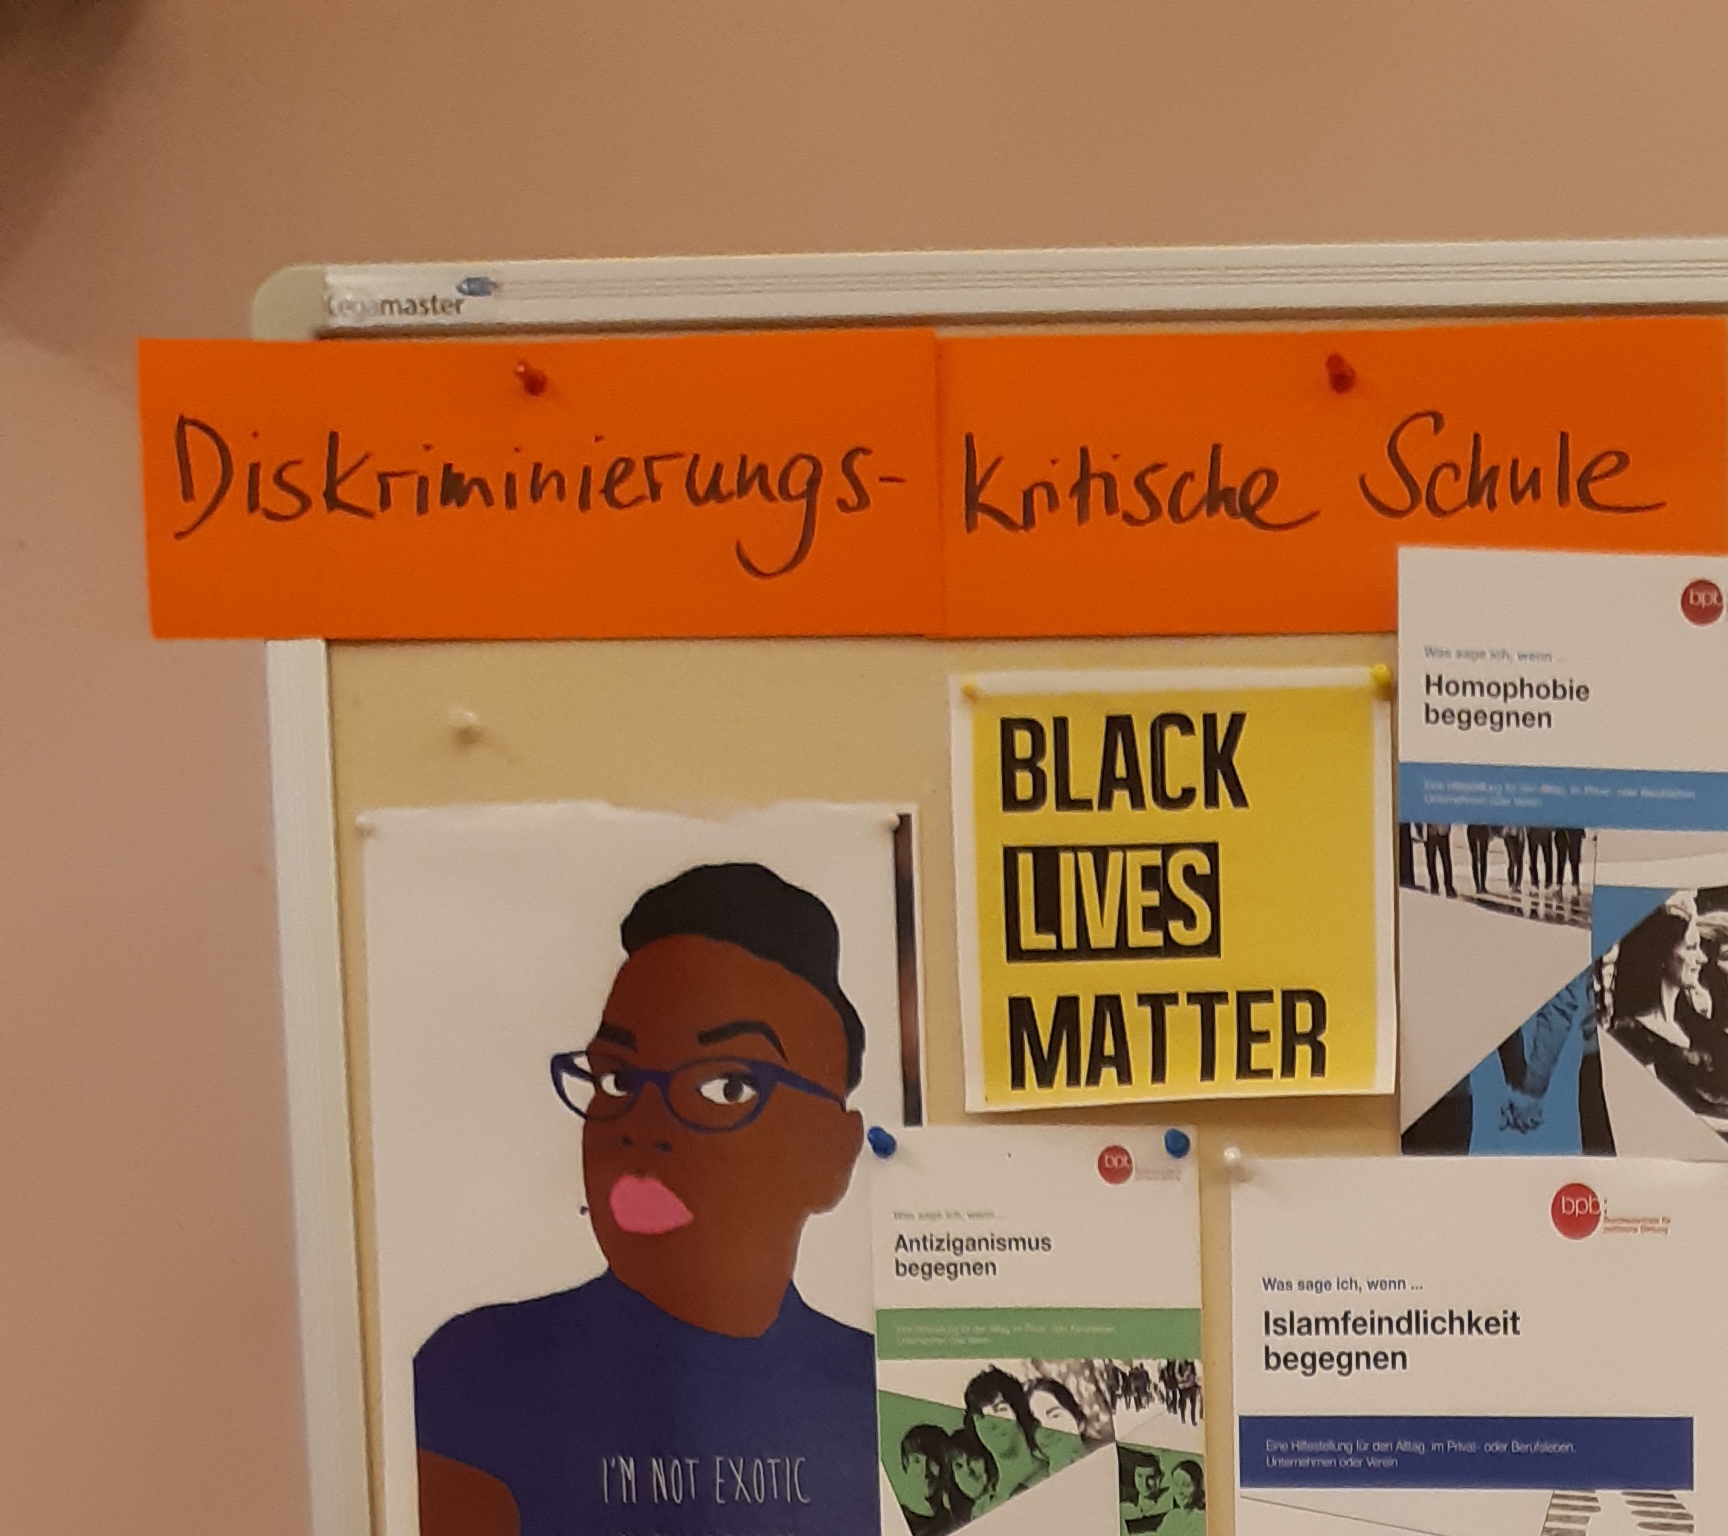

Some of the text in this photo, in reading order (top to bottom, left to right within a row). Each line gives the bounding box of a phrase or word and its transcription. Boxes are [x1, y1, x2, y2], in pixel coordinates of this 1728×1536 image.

[174, 412, 905, 579] Diskriminierungs-
[1359, 410, 1667, 519] Schule
[1424, 674, 1590, 702] Homophobie
[1424, 703, 1552, 732] begegnen
[1001, 712, 1249, 812] BLACK
[1018, 850, 1211, 950] LIVES
[1008, 988, 1327, 1090] MATTER
[895, 1234, 1052, 1256] Antiziganismus
[895, 1258, 997, 1280] begegnen
[1262, 1278, 1292, 1291] Was
[1298, 1281, 1332, 1294] sage
[1367, 1280, 1406, 1290] wenn
[1263, 1309, 1520, 1337] Islamfeindlichkeit
[1263, 1345, 1408, 1377] begegnen
[603, 1457, 810, 1503] I'M NOT EXOTIC
